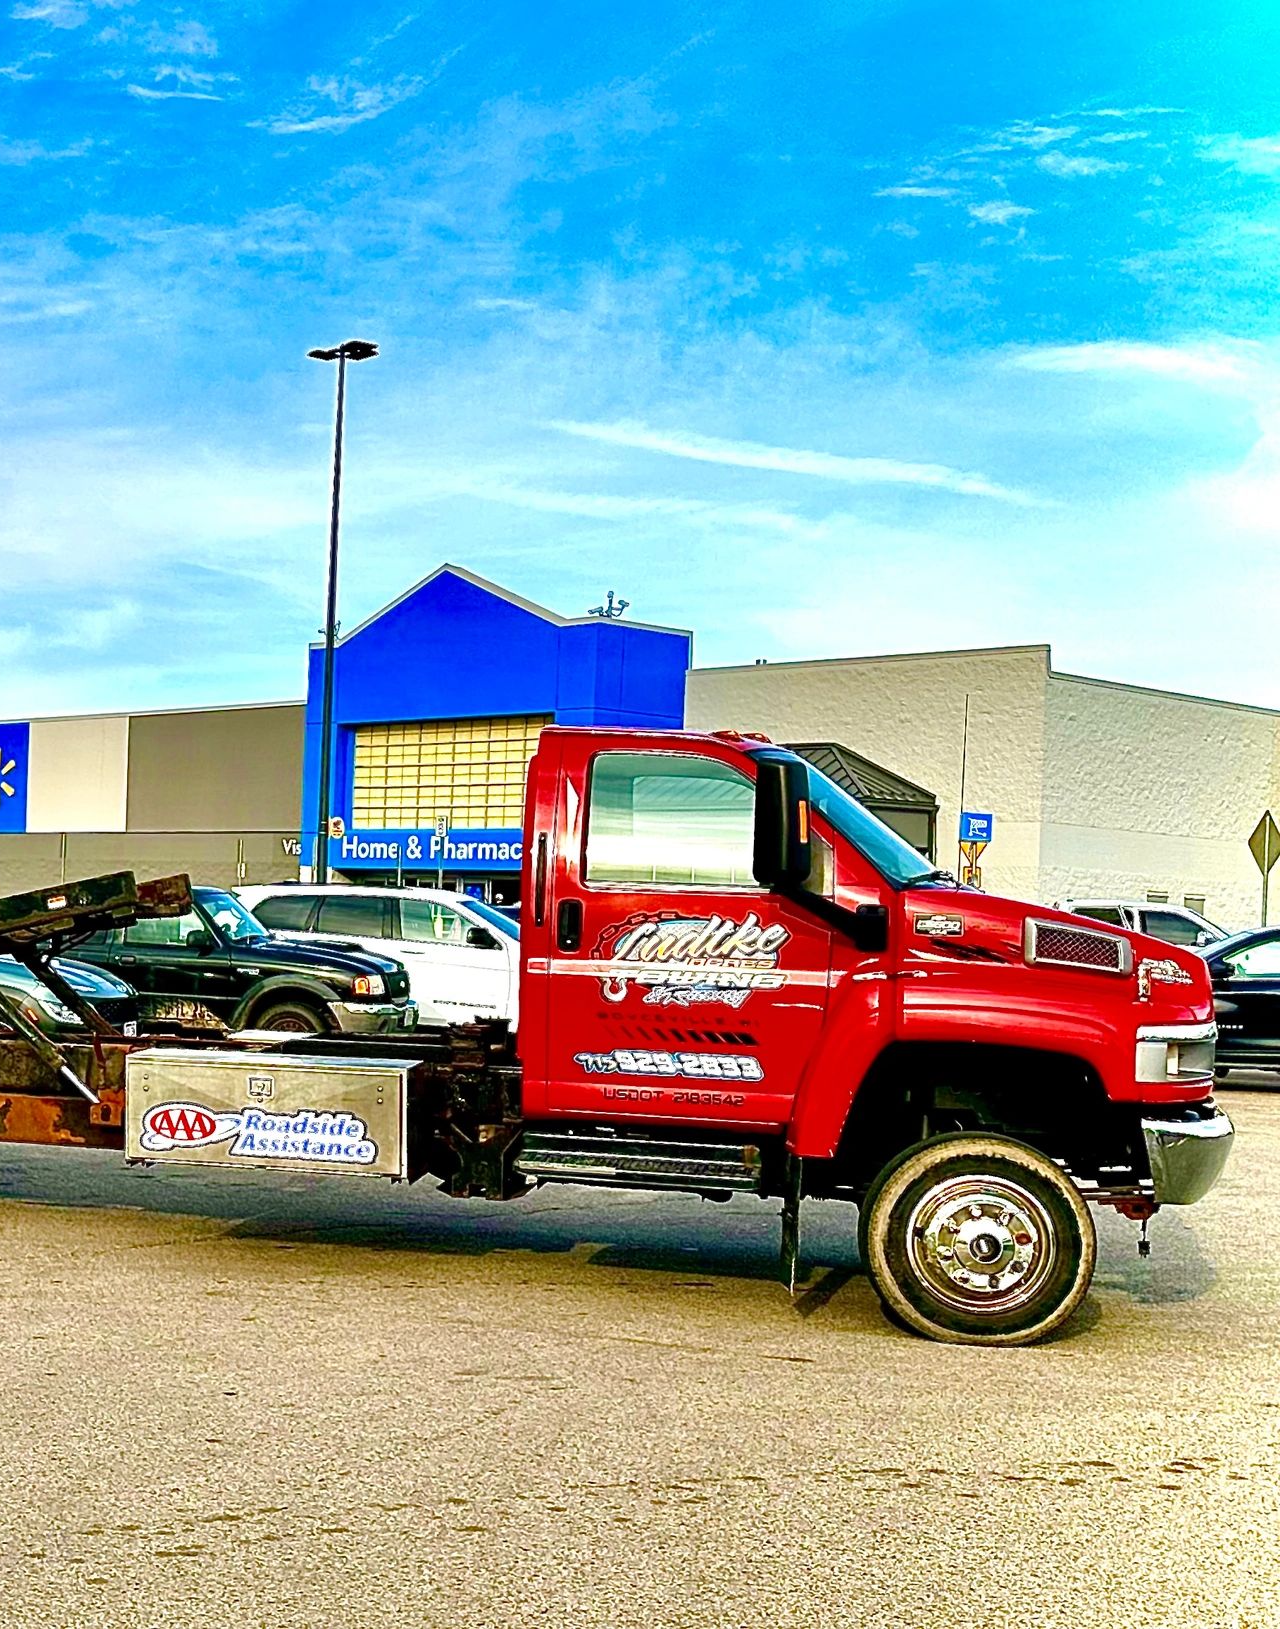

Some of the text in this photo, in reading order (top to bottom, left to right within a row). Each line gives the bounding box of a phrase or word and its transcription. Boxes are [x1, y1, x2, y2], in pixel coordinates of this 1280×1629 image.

[341, 835, 523, 861] Home & Pharmac
[608, 968, 788, 990] TOWING
[603, 1086, 745, 1107] USDOT 2183542
[150, 1108, 217, 1141] AAA
[242, 1112, 361, 1139] Roadside
[239, 1132, 371, 1159] Assistance
